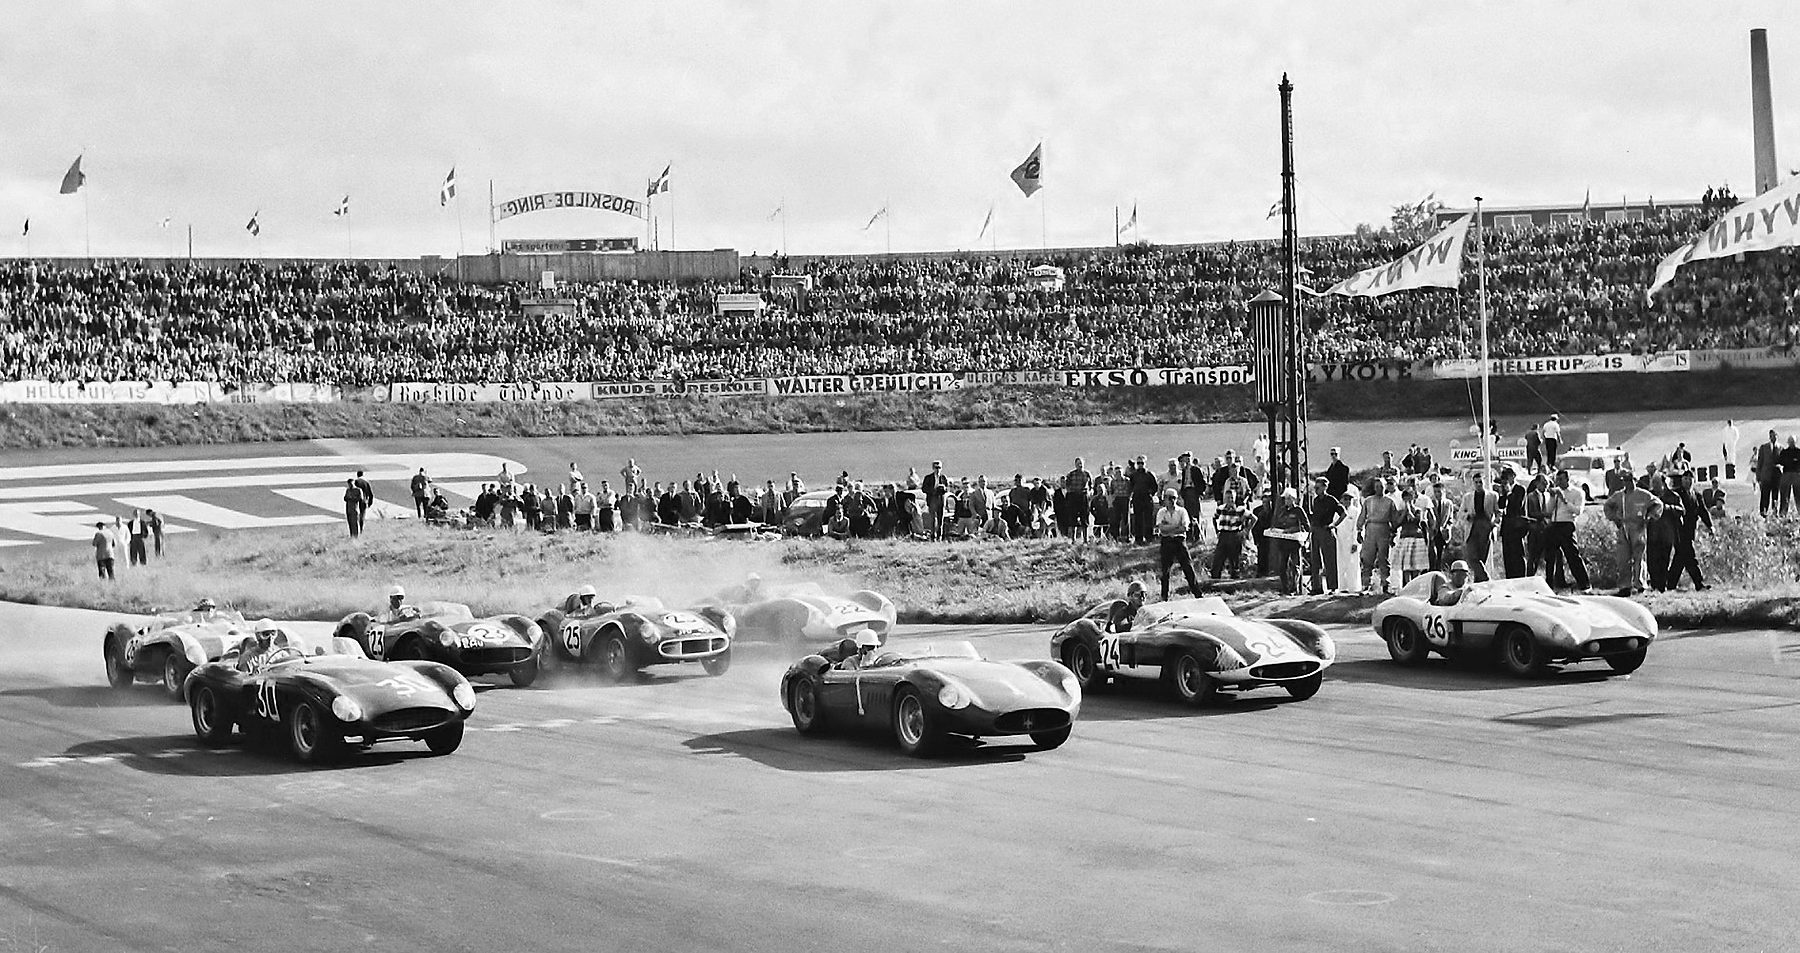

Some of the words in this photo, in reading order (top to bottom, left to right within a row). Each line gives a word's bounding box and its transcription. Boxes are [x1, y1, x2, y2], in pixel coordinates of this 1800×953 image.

[1493, 356, 1583, 374] HELLERUP
[1604, 356, 1623, 369] IS
[1675, 353, 1687, 366] IS
[774, 378, 845, 394] WALTER
[944, 375, 961, 390] A/S
[1023, 371, 1061, 382] KAFFE
[1064, 368, 1149, 387] EKSO
[1158, 367, 1253, 385] Transpor
[400, 385, 477, 403] Roskilde
[597, 384, 656, 396] KNUDS
[1453, 450, 1477, 459] KING
[474, 627, 506, 640] 23
[1424, 613, 1446, 640] 26
[369, 630, 384, 656] 23
[565, 625, 580, 650] 25
[1100, 638, 1121, 671] 24
[256, 679, 281, 722] 30
